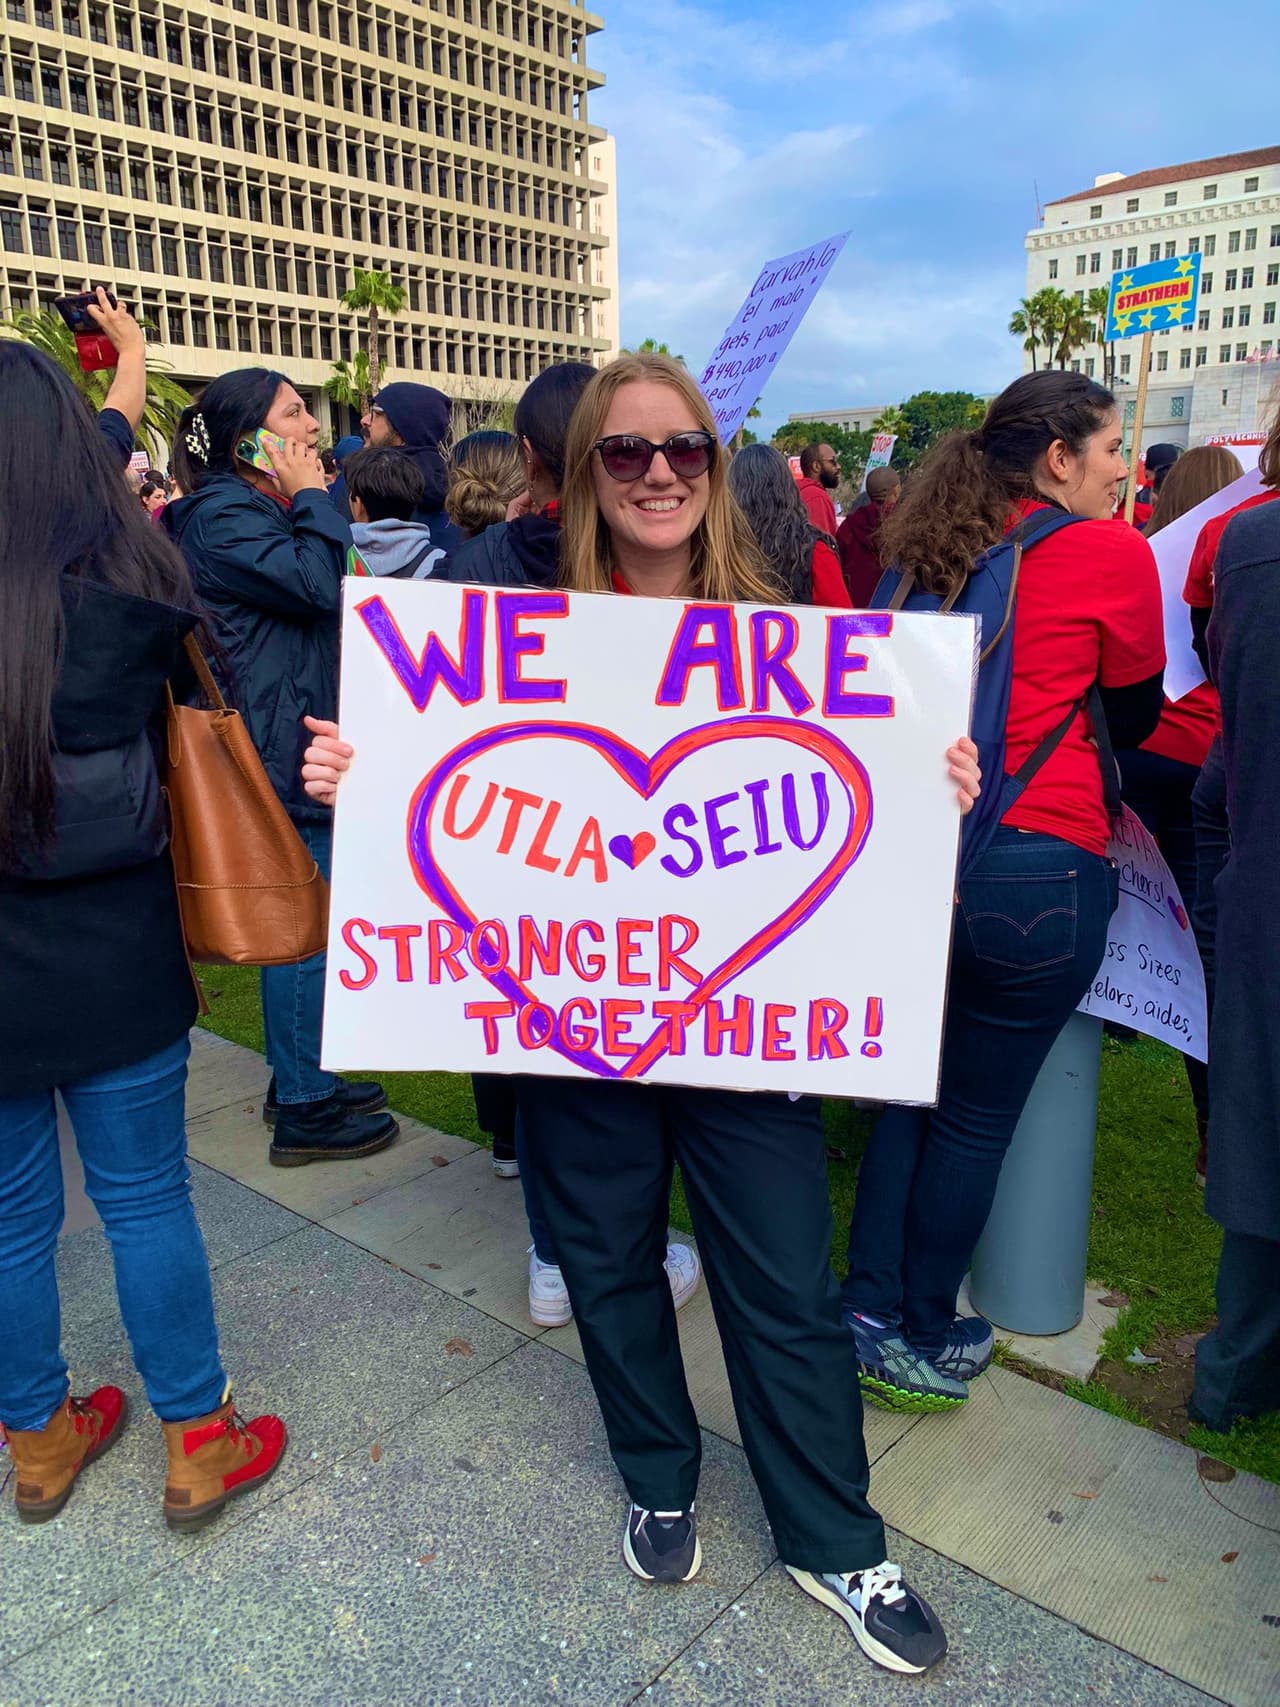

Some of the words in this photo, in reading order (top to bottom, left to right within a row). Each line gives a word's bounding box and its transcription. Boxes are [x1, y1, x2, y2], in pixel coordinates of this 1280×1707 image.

[751, 243, 836, 297] Carvahlo
[1117, 281, 1190, 310] STRATHERN
[715, 332, 751, 360] gets
[754, 312, 793, 348] paid
[701, 354, 767, 384] $440,000
[768, 352, 777, 363] a
[704, 376, 746, 402] ear!
[353, 588, 570, 714] WE
[655, 602, 896, 719] ARE
[442, 773, 609, 883] UTLA
[660, 771, 828, 878] SEIU
[1112, 856, 1166, 908] chers!
[338, 913, 704, 991] STRONGER
[1137, 943, 1182, 986] Sizes
[464, 995, 884, 1061] TOGETHER!
[1143, 1000, 1193, 1043] aides,
